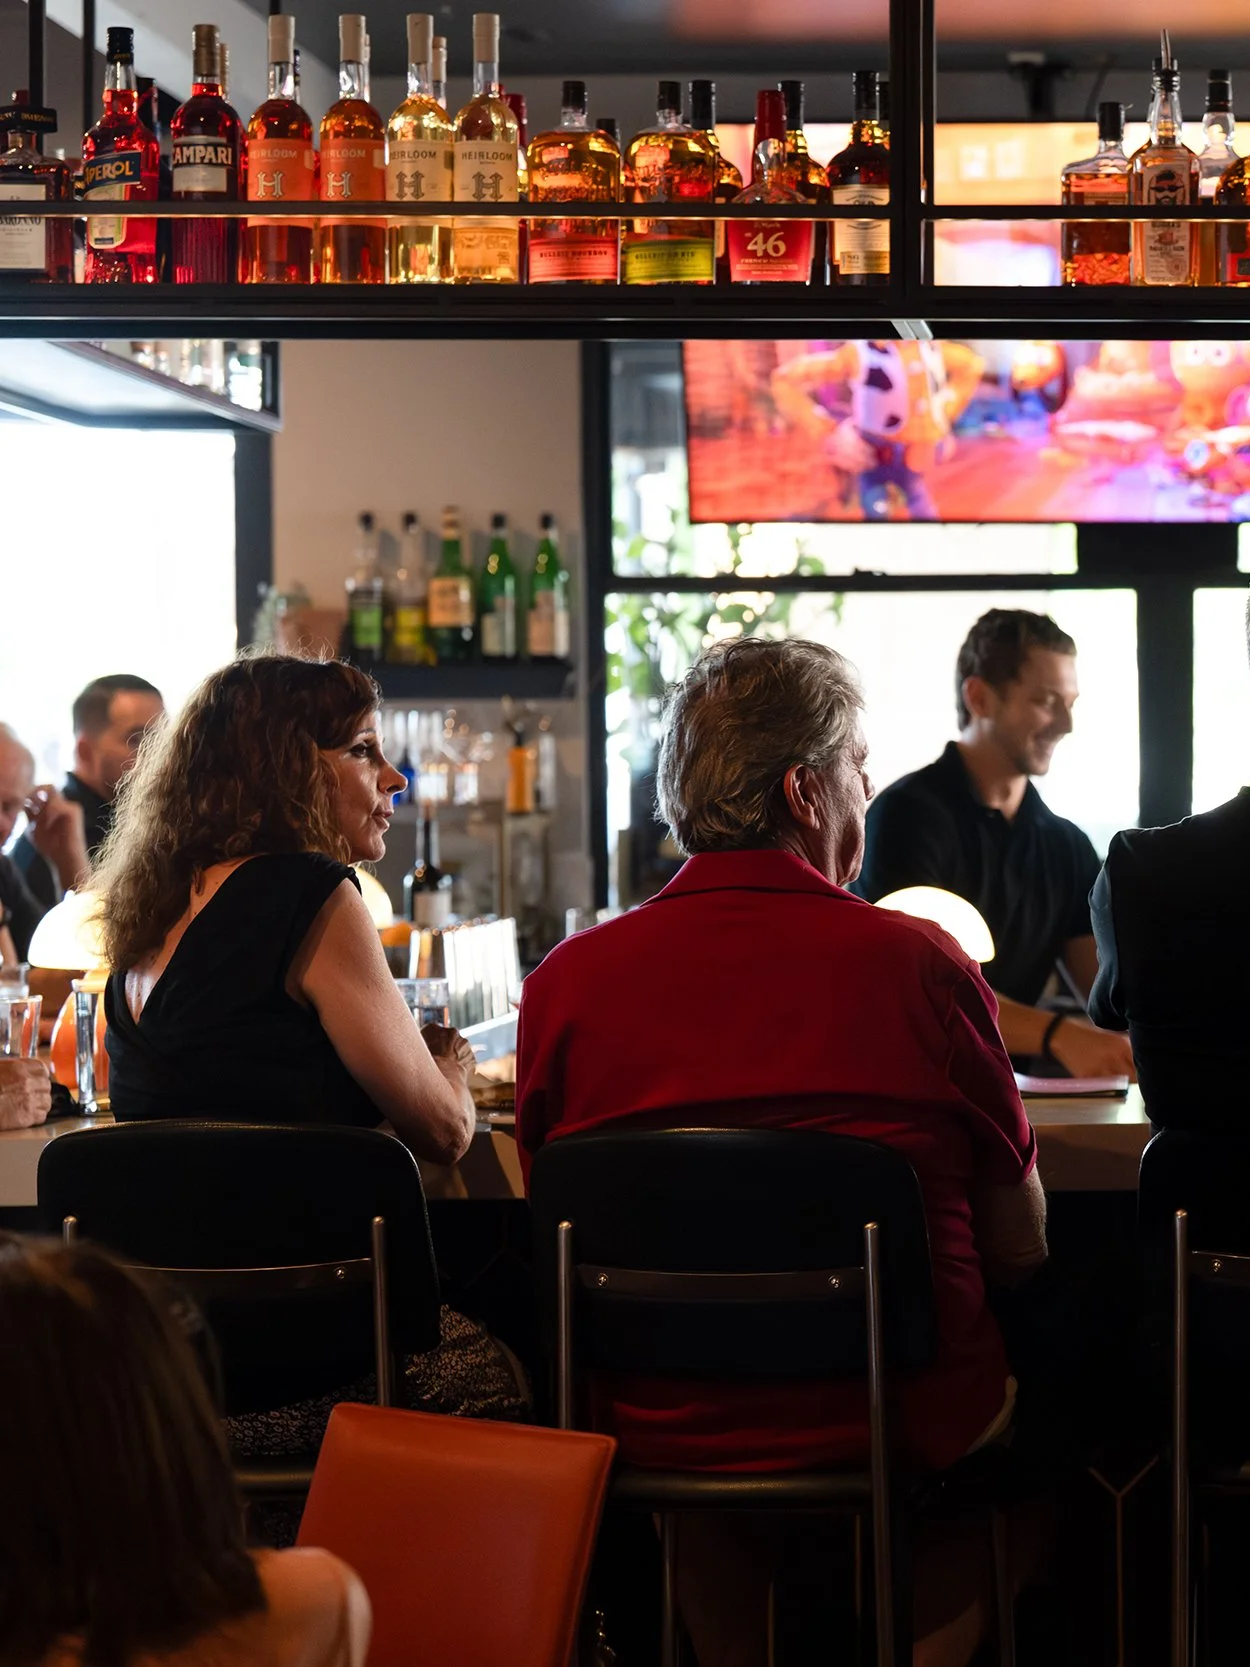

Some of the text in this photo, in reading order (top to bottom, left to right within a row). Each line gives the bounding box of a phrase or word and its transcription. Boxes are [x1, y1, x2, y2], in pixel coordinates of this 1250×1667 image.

[172, 145, 233, 165] AMPARI
[390, 150, 436, 160] HEIRLOOM
[463, 151, 512, 161] HEIRLOOM
[257, 171, 283, 198] H
[327, 171, 351, 198] H
[396, 170, 425, 200] H
[472, 171, 503, 201] H
[747, 231, 786, 257] 46
